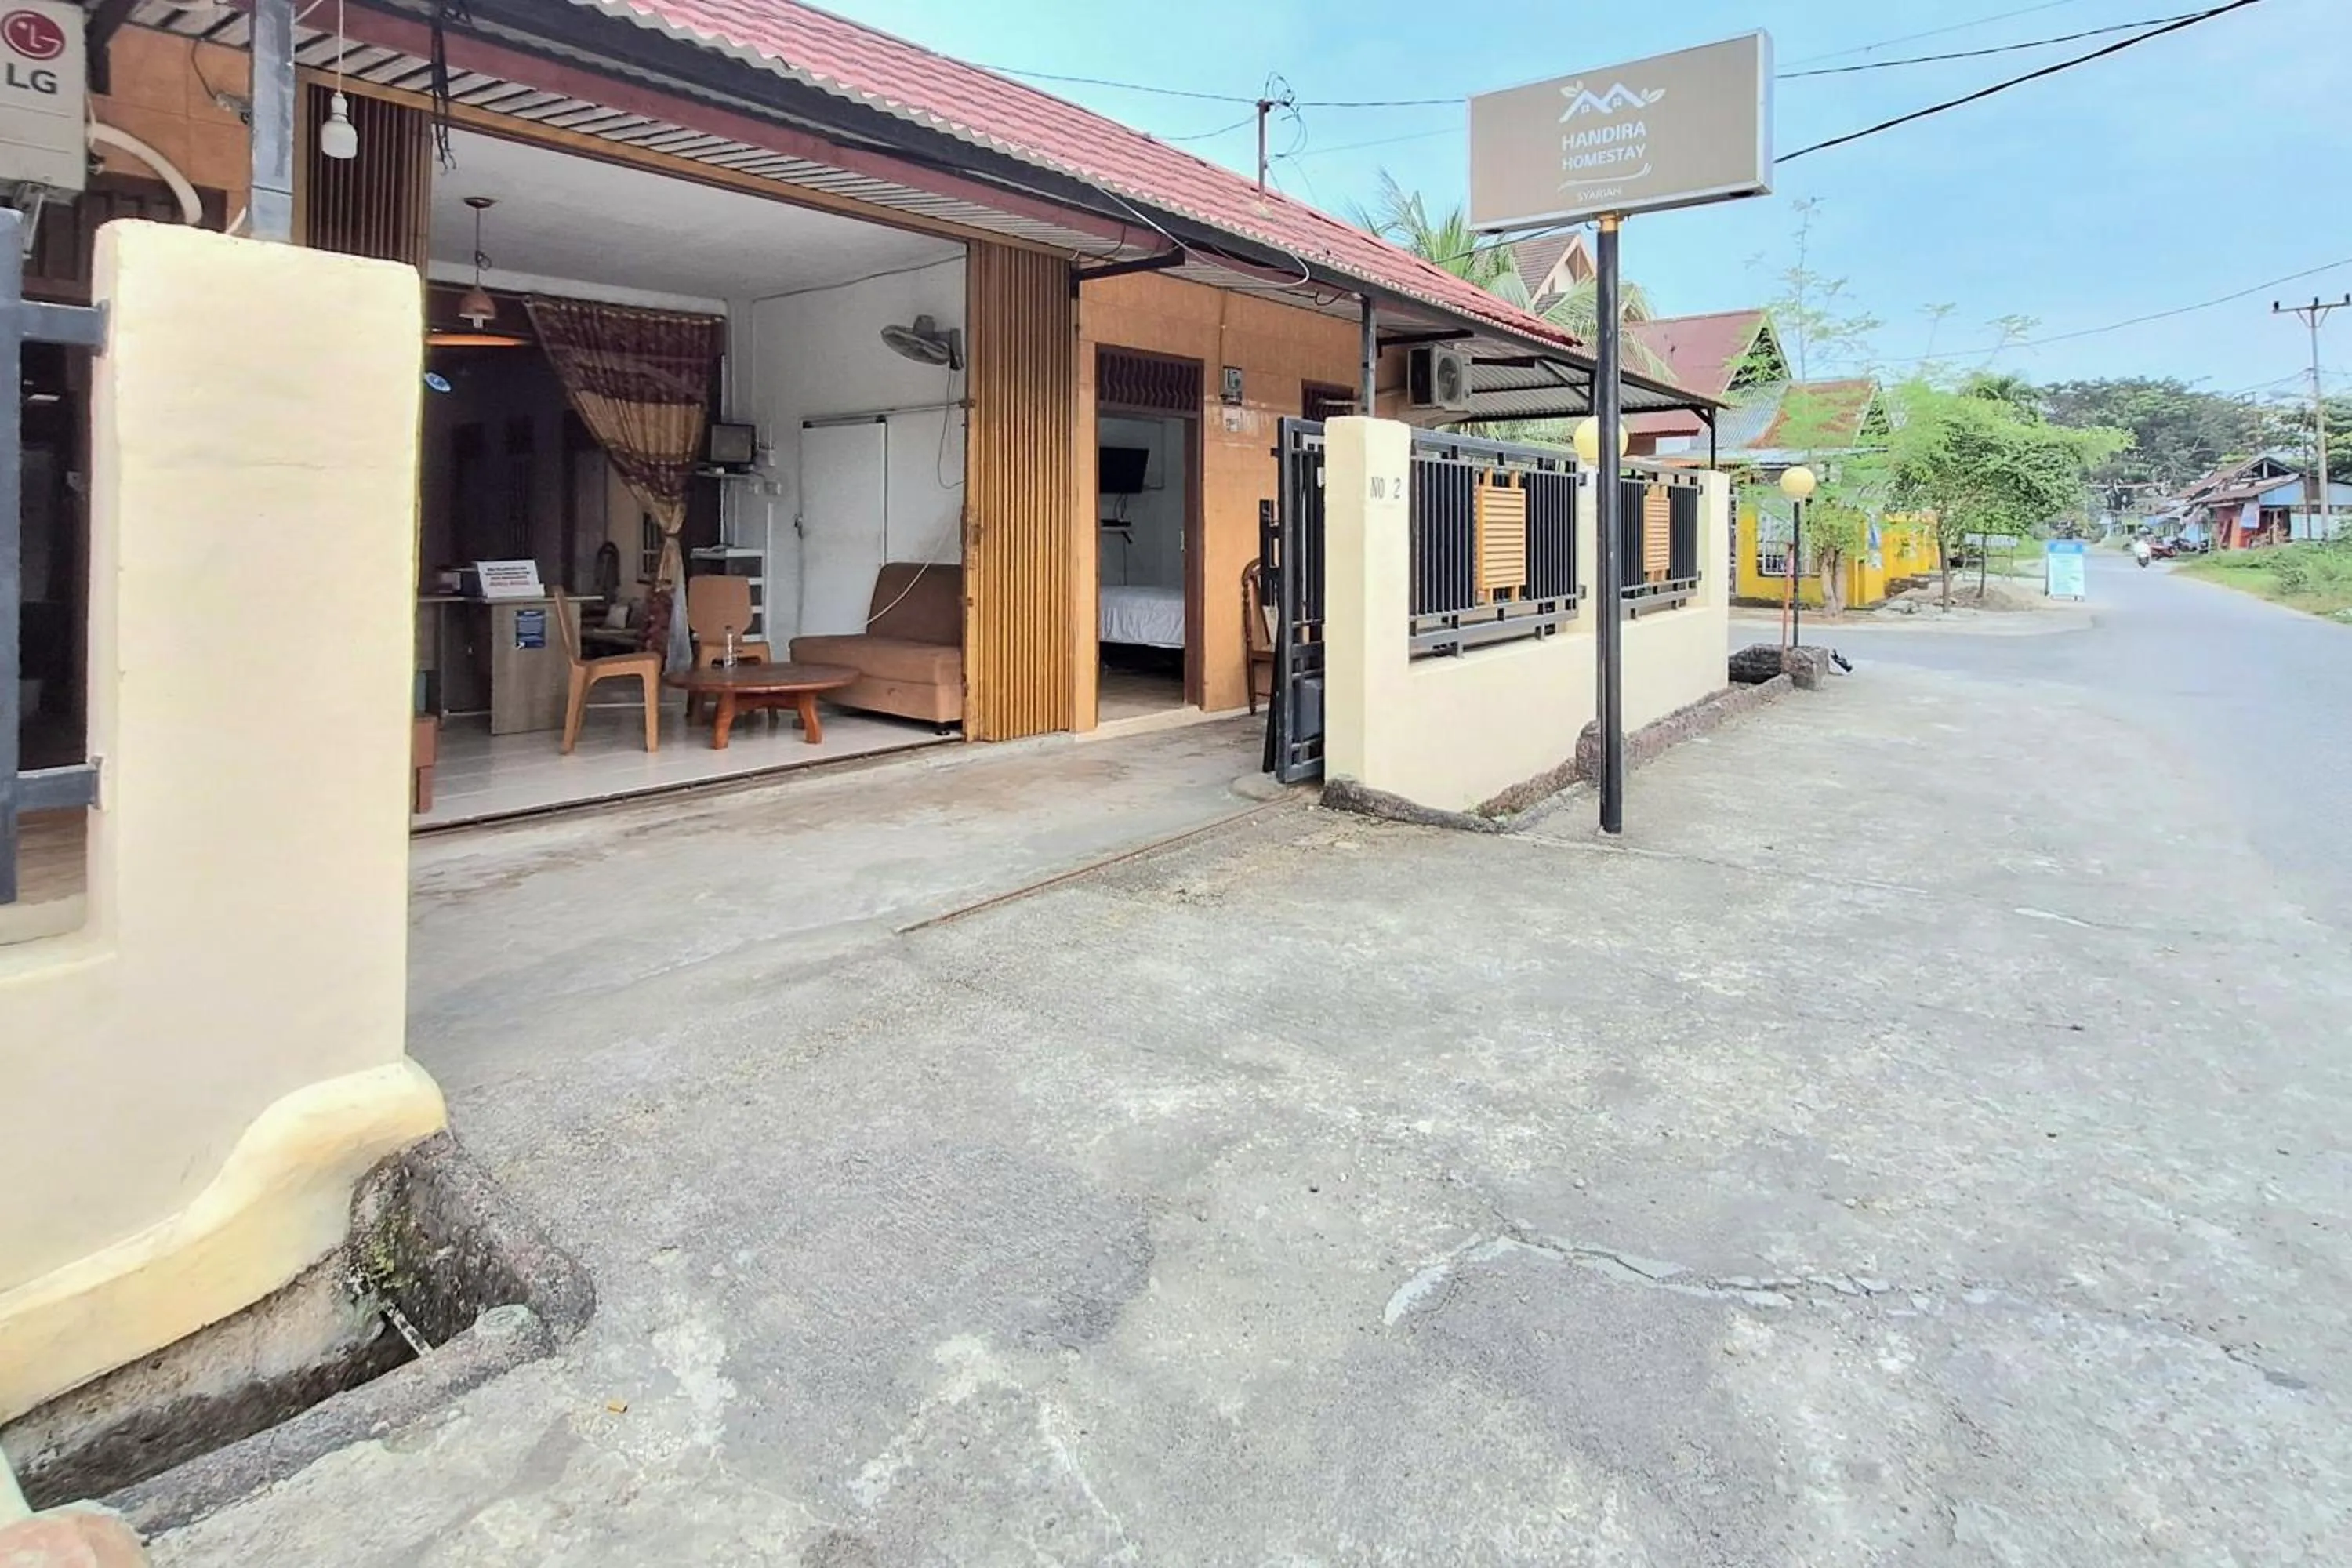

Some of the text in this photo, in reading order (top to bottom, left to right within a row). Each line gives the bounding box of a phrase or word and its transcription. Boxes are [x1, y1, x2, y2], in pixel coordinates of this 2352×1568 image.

[5, 62, 58, 95] LG
[1562, 120, 1646, 151] HANDIRA
[1562, 143, 1646, 171] HOMESTAY
[1370, 476, 1402, 499] NO 2
